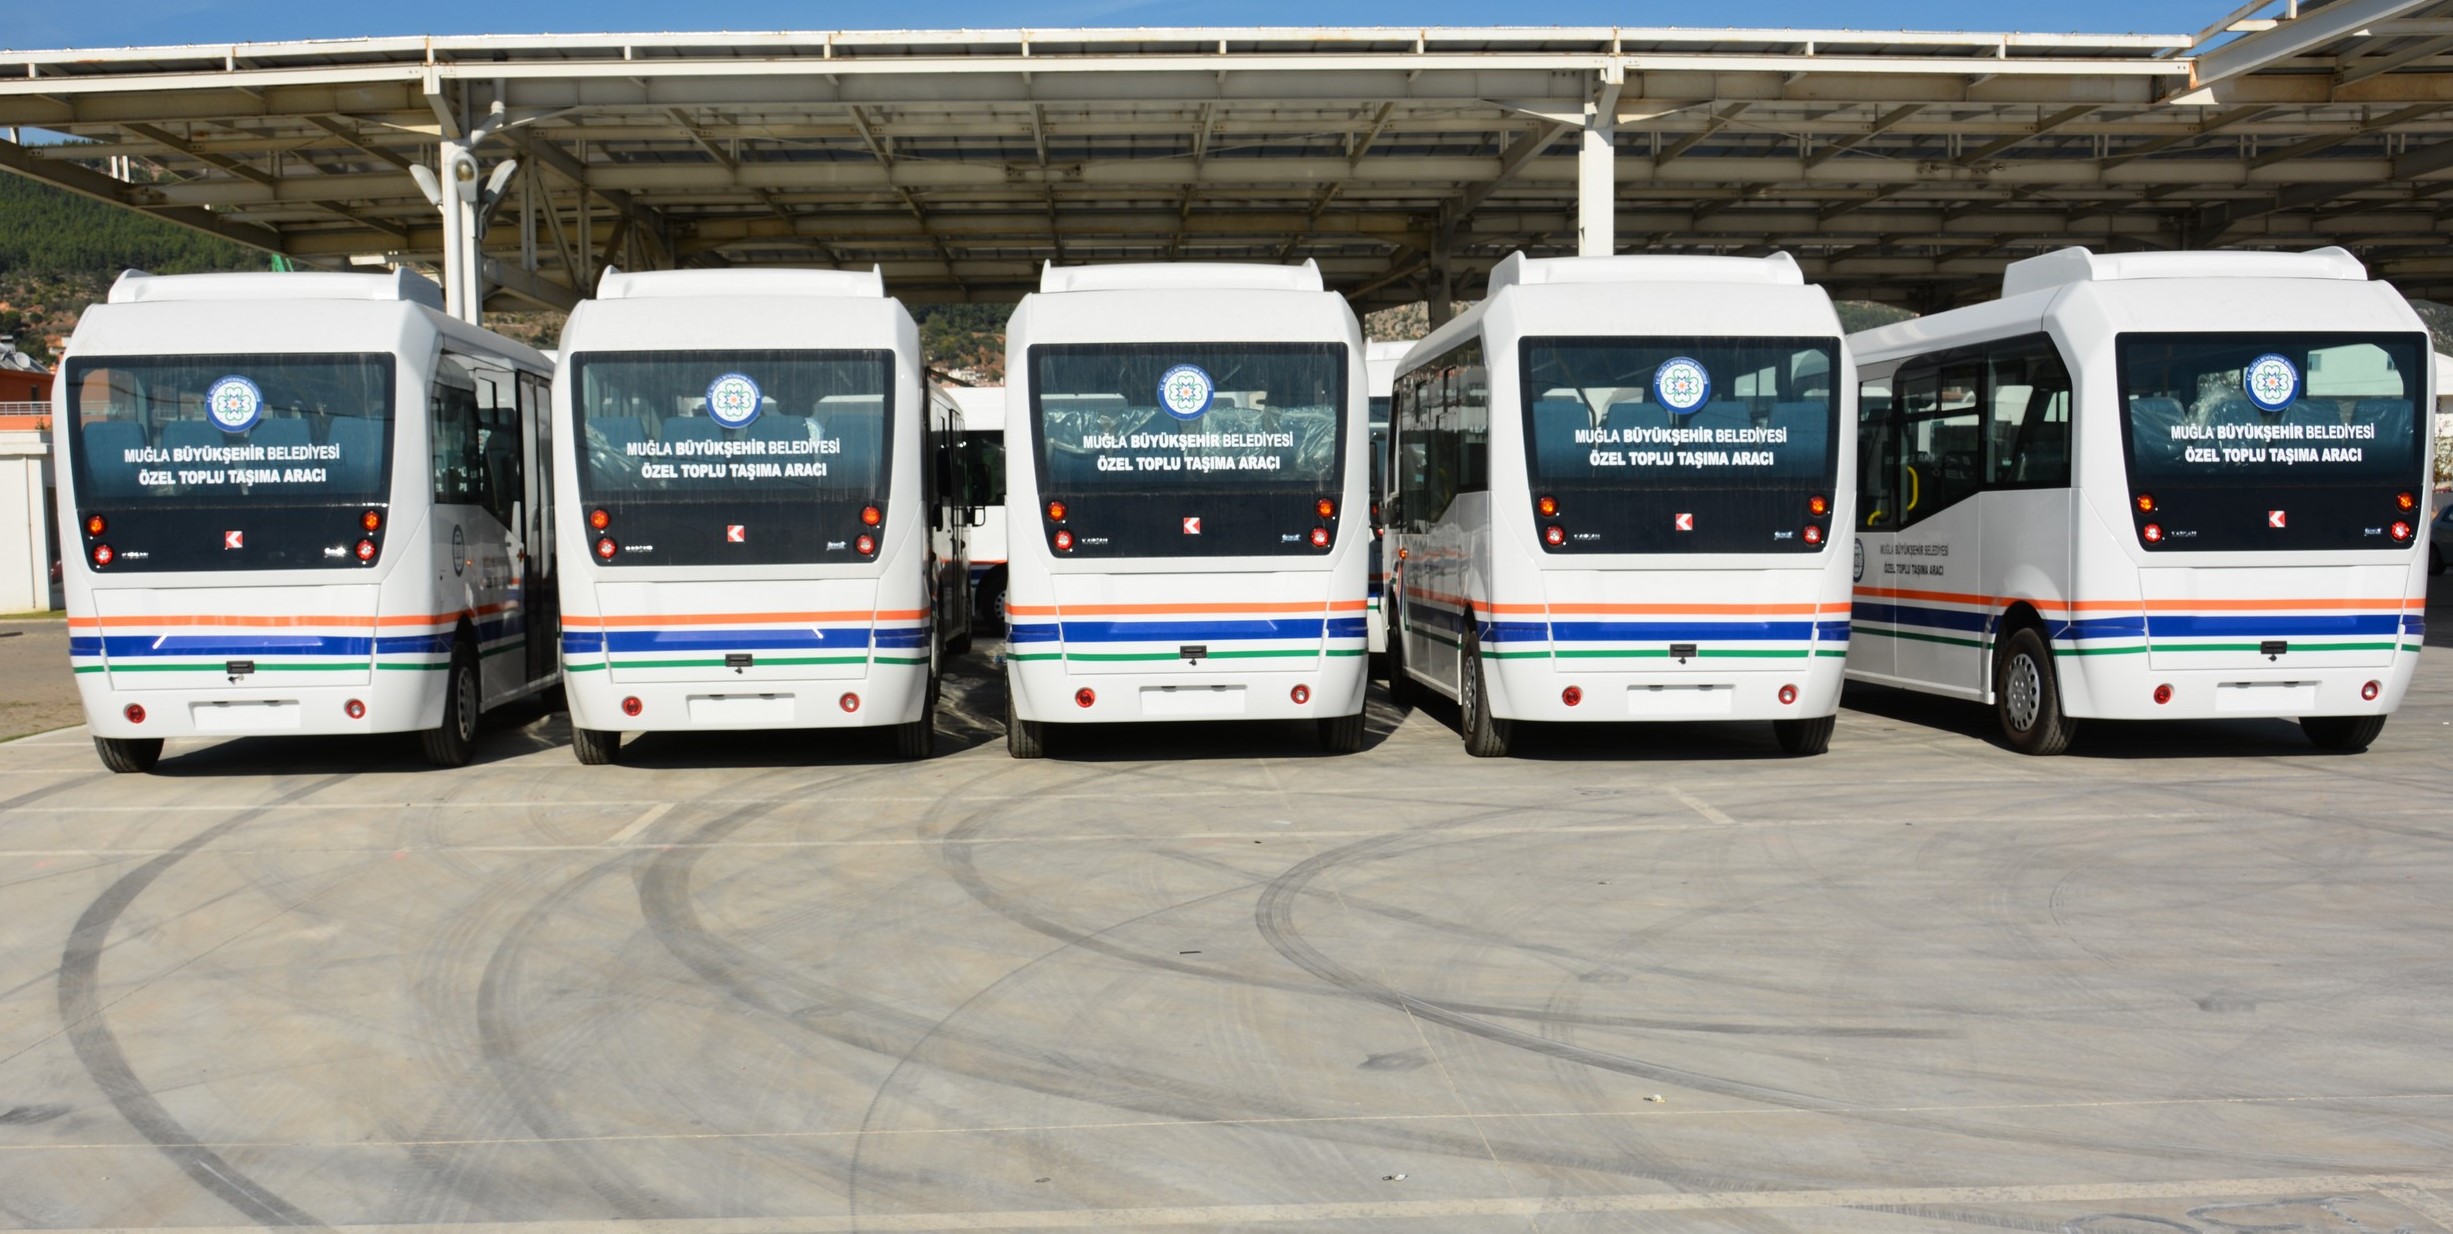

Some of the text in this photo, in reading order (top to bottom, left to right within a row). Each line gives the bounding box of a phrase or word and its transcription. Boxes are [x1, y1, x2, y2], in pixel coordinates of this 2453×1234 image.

[1083, 431, 1293, 451] MUĞLA BÜYÜKŞEHİR BELEDİYESİ
[1575, 426, 1787, 445] MUĞLA BÜYÜKŞEHİR BELEDİYESİ
[2171, 423, 2375, 442] MUĞLA BÜYÜKŞEHİR BELEDİYESİ
[124, 443, 340, 464] MUĞLA BÜYÜKŞEHİR BELEDİYESİ
[627, 438, 840, 458] MUĞLA BÜYÜKŞEHİR BELEDİYESİ
[2185, 446, 2362, 465] ÖZEL TOPLU TAŞIMA ARACI
[1097, 455, 1133, 471] ÖZEL
[1136, 457, 1181, 471] TOPLU
[1184, 456, 1236, 473] TAŞIMA
[1589, 450, 1774, 468] ÖZEL TOPLU TAŞIMA ARACI
[139, 468, 326, 486] ÖZEL TOPLU TAŞIMA ARACI
[641, 462, 827, 480] ÖZEL TOPLU TAŞIMA ARACI
